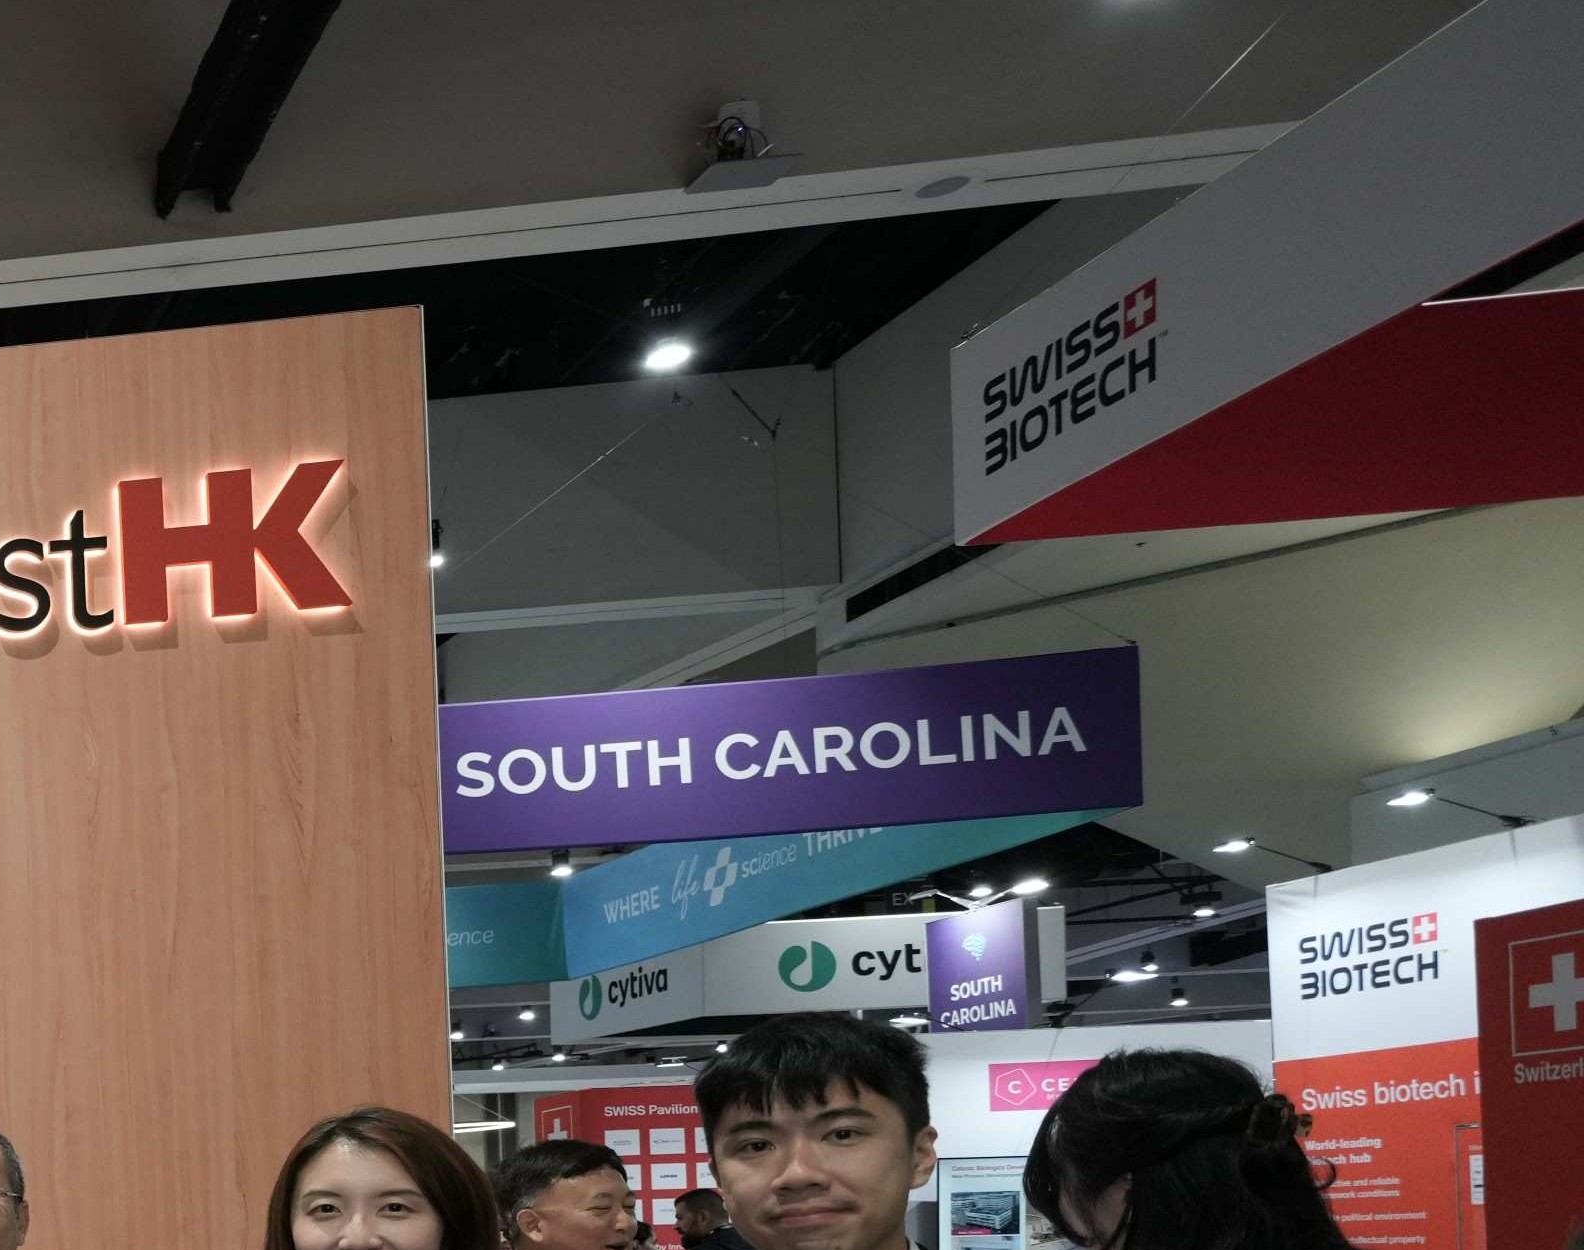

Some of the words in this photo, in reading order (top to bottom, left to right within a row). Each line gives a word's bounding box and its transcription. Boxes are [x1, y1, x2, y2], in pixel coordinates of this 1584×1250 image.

[983, 301, 1121, 423] SWISS
[984, 336, 1157, 477] BIOTECH
[454, 736, 693, 798] SOUTH
[713, 706, 1088, 780] CAROLINA
[603, 885, 661, 925] WHERE
[671, 853, 700, 921] life
[740, 841, 798, 880] science
[447, 928, 494, 947] ence
[1299, 918, 1410, 965] SWISS
[852, 943, 921, 980] cyt
[1300, 949, 1440, 1000] BIOTECH
[607, 965, 669, 1008] cytiva
[949, 974, 1003, 1002] SOUTH
[940, 999, 1017, 1029] CAROLINA
[1008, 1080, 1022, 1094] C
[1514, 1059, 1584, 1084] Switzerl
[1301, 1088, 1368, 1111] Swiss
[1373, 1073, 1466, 1105] biotech
[604, 1105, 646, 1117] SWISS
[648, 1103, 698, 1116] Pavilion
[1304, 1137, 1383, 1151] World-leading
[1350, 1153, 1372, 1164] hub
[1342, 1213, 1373, 1222] political
